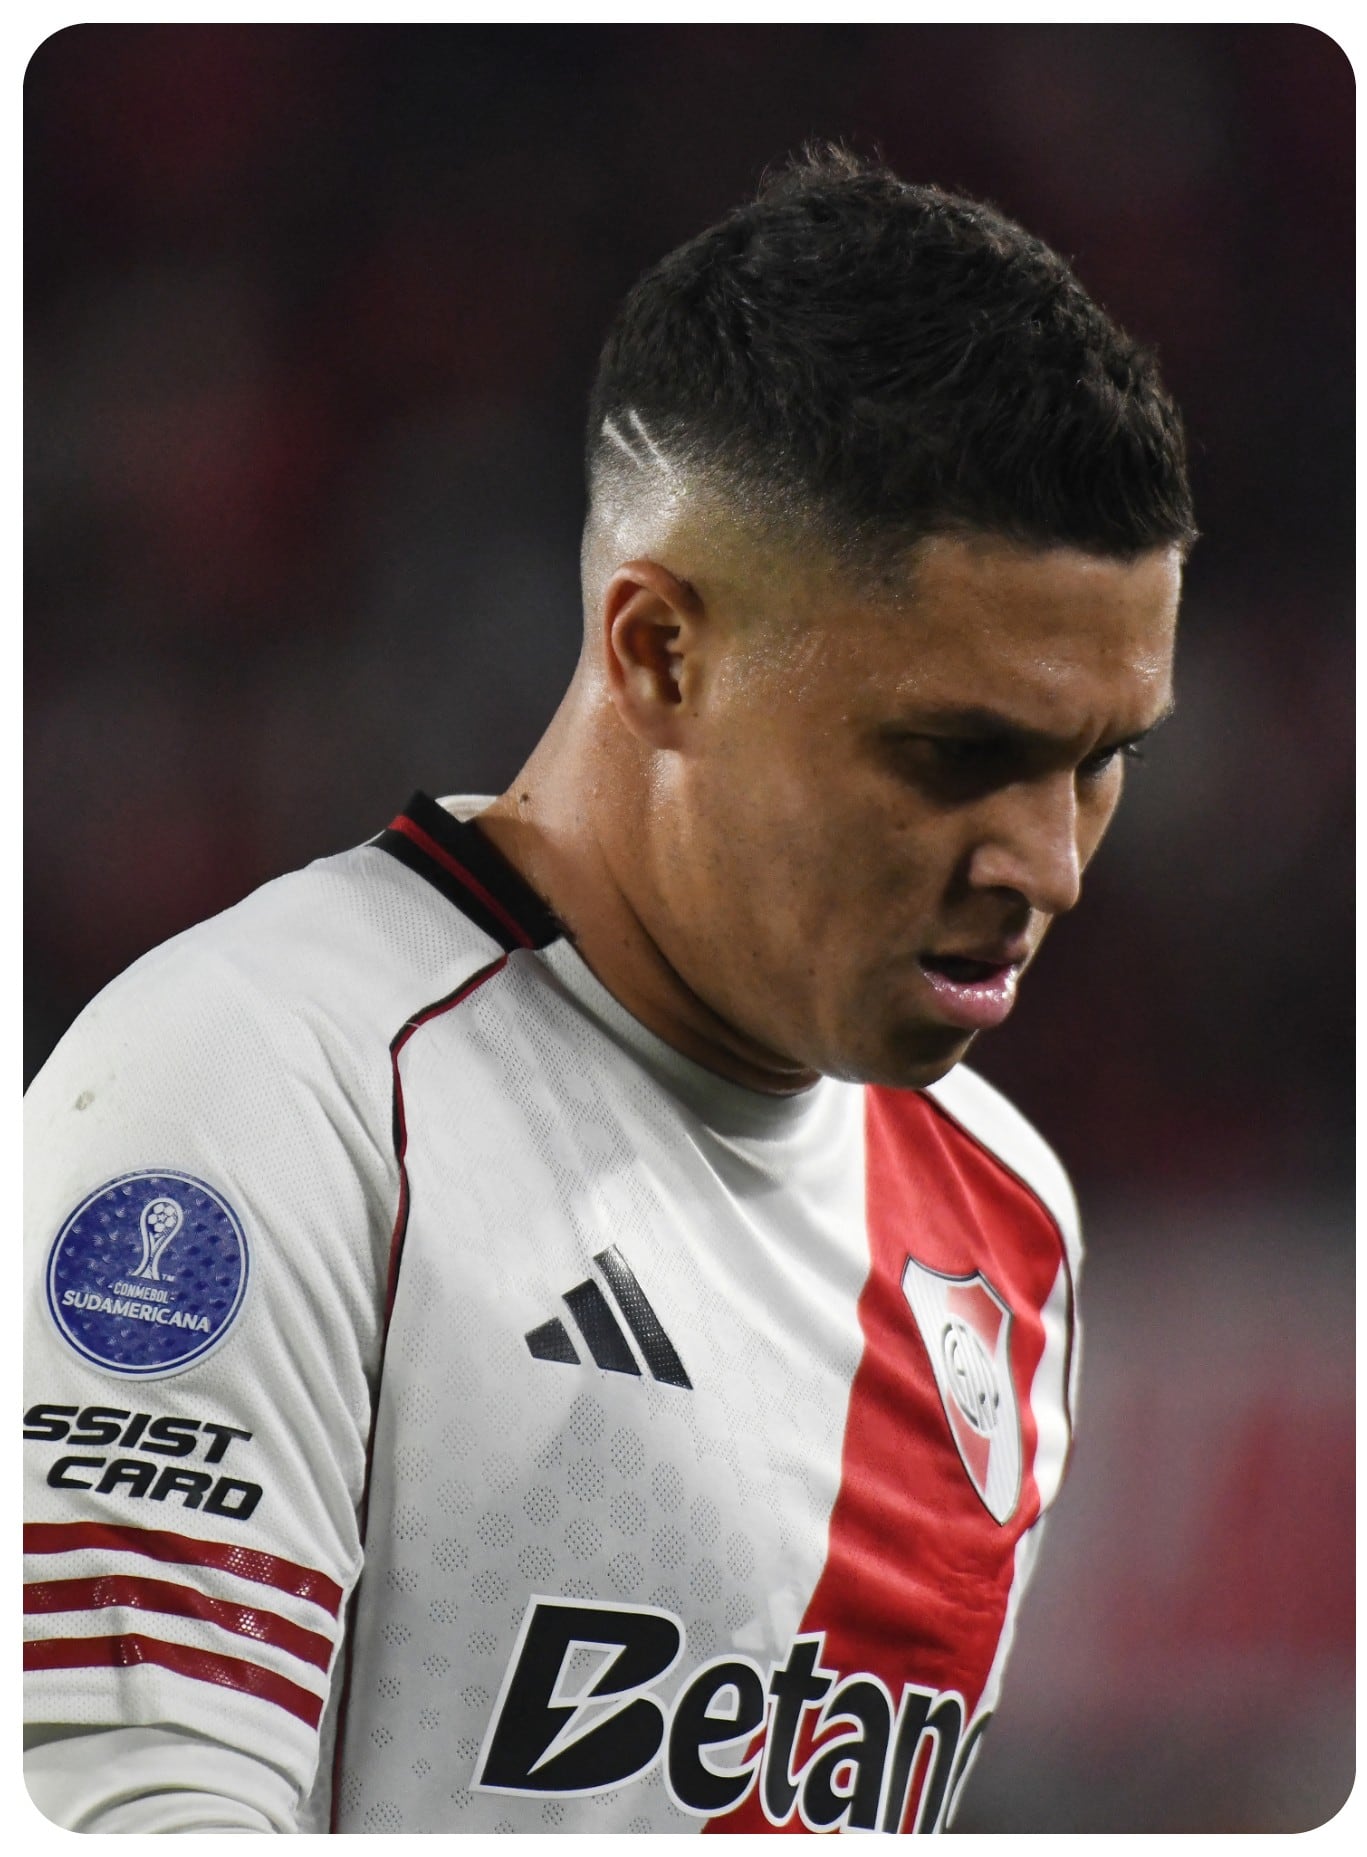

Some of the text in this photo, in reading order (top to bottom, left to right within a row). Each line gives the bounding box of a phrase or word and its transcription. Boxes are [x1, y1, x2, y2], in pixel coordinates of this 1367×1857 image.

[62, 1289, 211, 1333] SUDAMERICANA
[112, 1281, 169, 1304] CONMEBOL
[23, 1404, 253, 1463] SSIST
[47, 1456, 263, 1521] CARD
